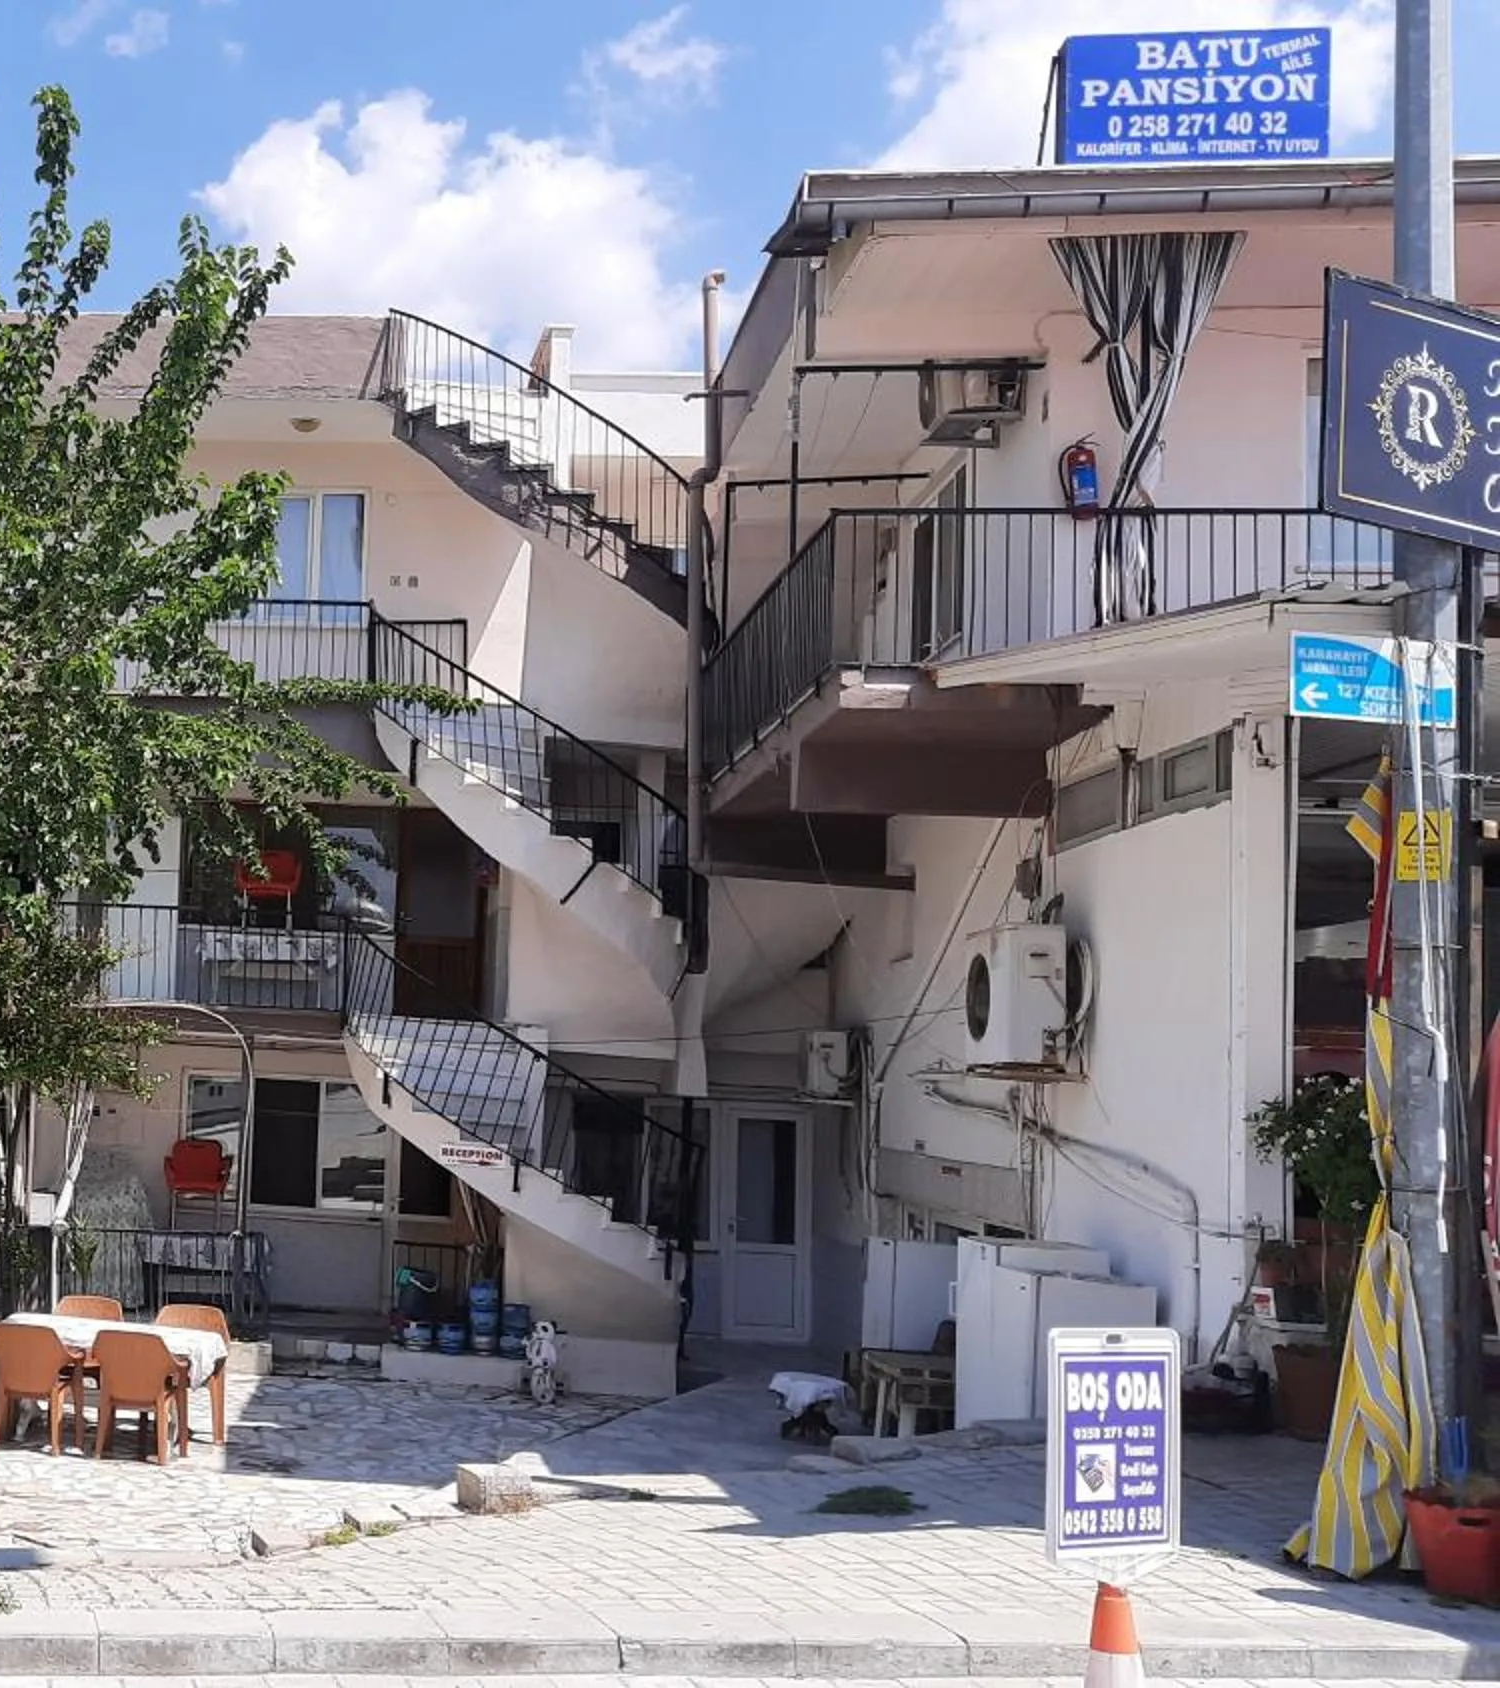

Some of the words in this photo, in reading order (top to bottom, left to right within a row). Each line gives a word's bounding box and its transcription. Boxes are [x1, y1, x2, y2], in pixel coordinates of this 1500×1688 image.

[1137, 37, 1261, 71] BATU
[1262, 34, 1321, 60] TERMAL
[1081, 70, 1317, 107] PANSİYON
[1108, 115, 1122, 138] 0
[1128, 114, 1171, 137] 258
[1175, 113, 1217, 136] 271
[1224, 112, 1254, 135] 40
[1259, 111, 1288, 134] 32
[1076, 140, 1143, 157] KALORİFER
[1150, 140, 1189, 155] KLİMA
[1266, 138, 1284, 153] TV
[1285, 138, 1320, 153] UYDU
[1405, 385, 1443, 448] R
[1337, 684, 1361, 699] 127
[1066, 1371, 1110, 1423] BOŞ
[1115, 1371, 1163, 1411] ODA
[1064, 1509, 1098, 1535] 0542
[1100, 1507, 1125, 1534] 558
[1127, 1507, 1136, 1532] 0
[1138, 1506, 1162, 1531] 558
